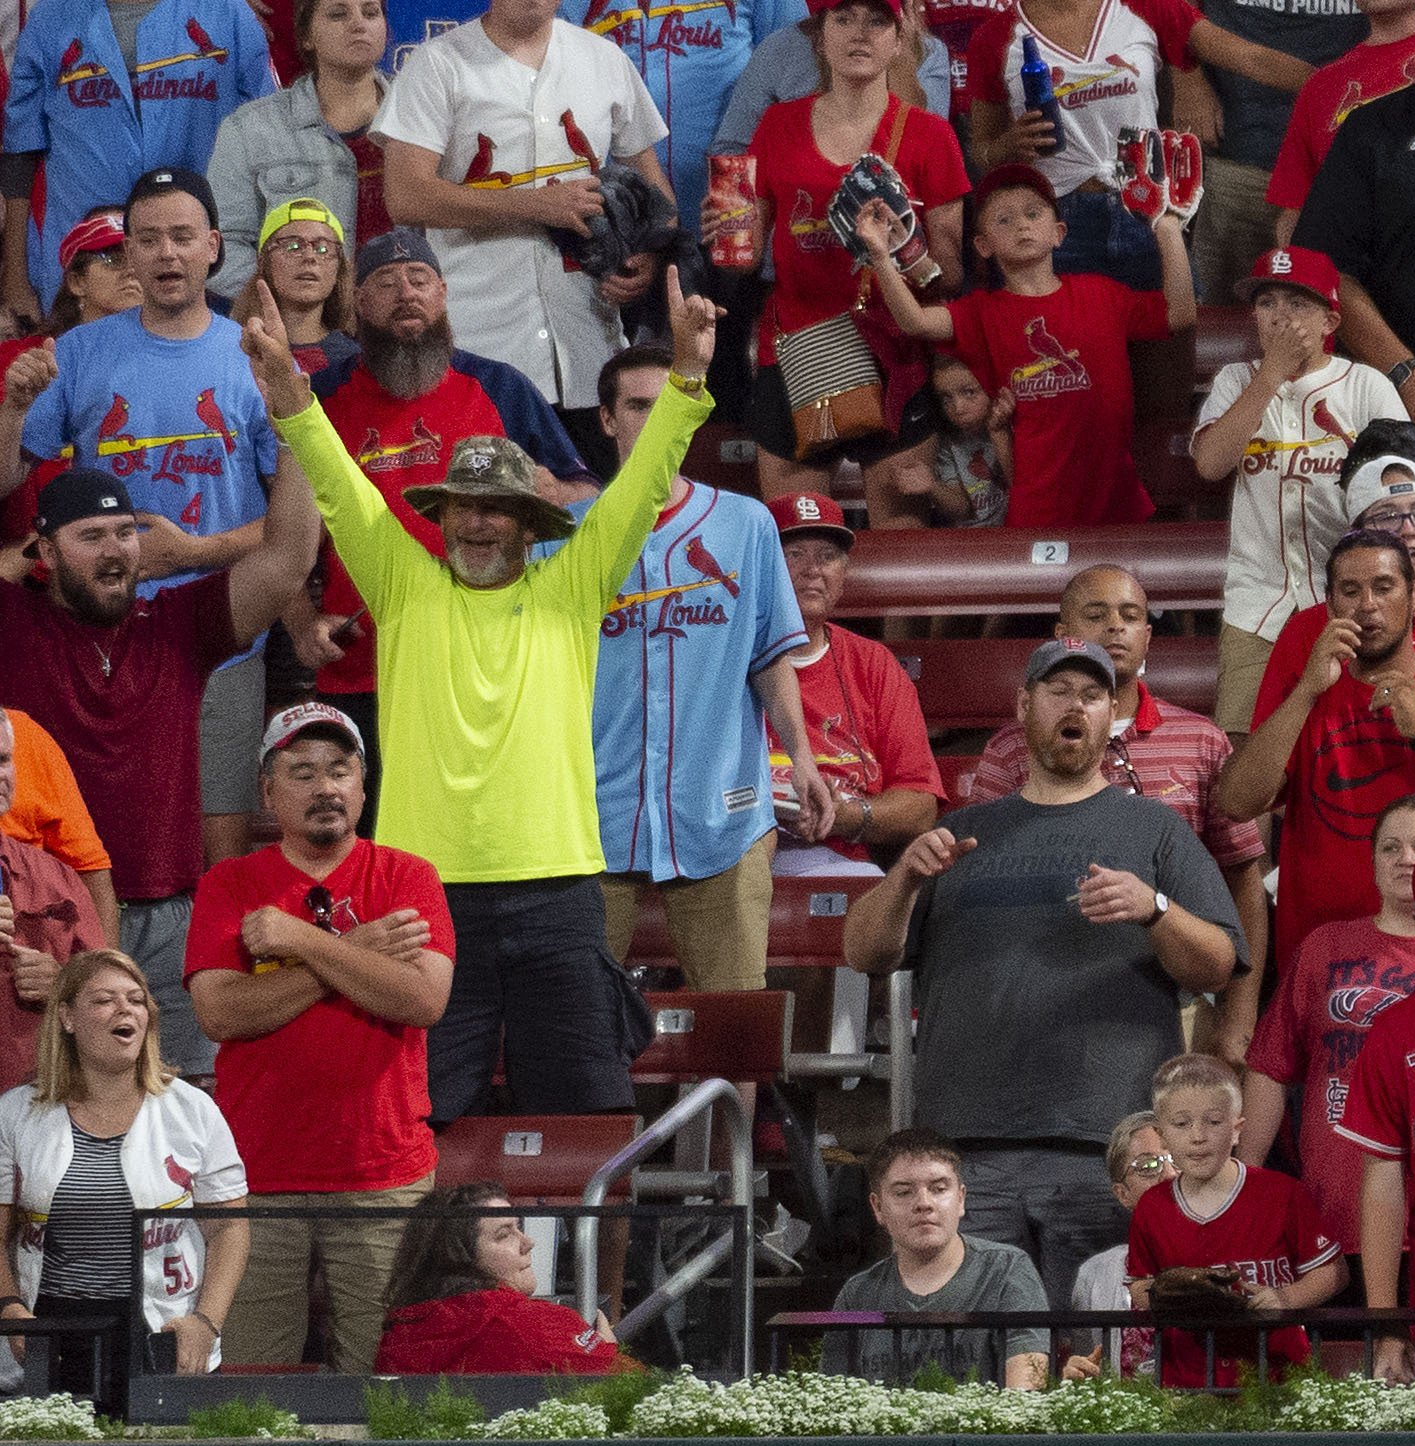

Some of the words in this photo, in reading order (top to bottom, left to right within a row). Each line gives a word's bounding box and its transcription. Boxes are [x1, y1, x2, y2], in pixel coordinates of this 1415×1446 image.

[153, 438, 222, 485] Louis
[1044, 544, 1056, 562] 2
[648, 591, 729, 639] Louis
